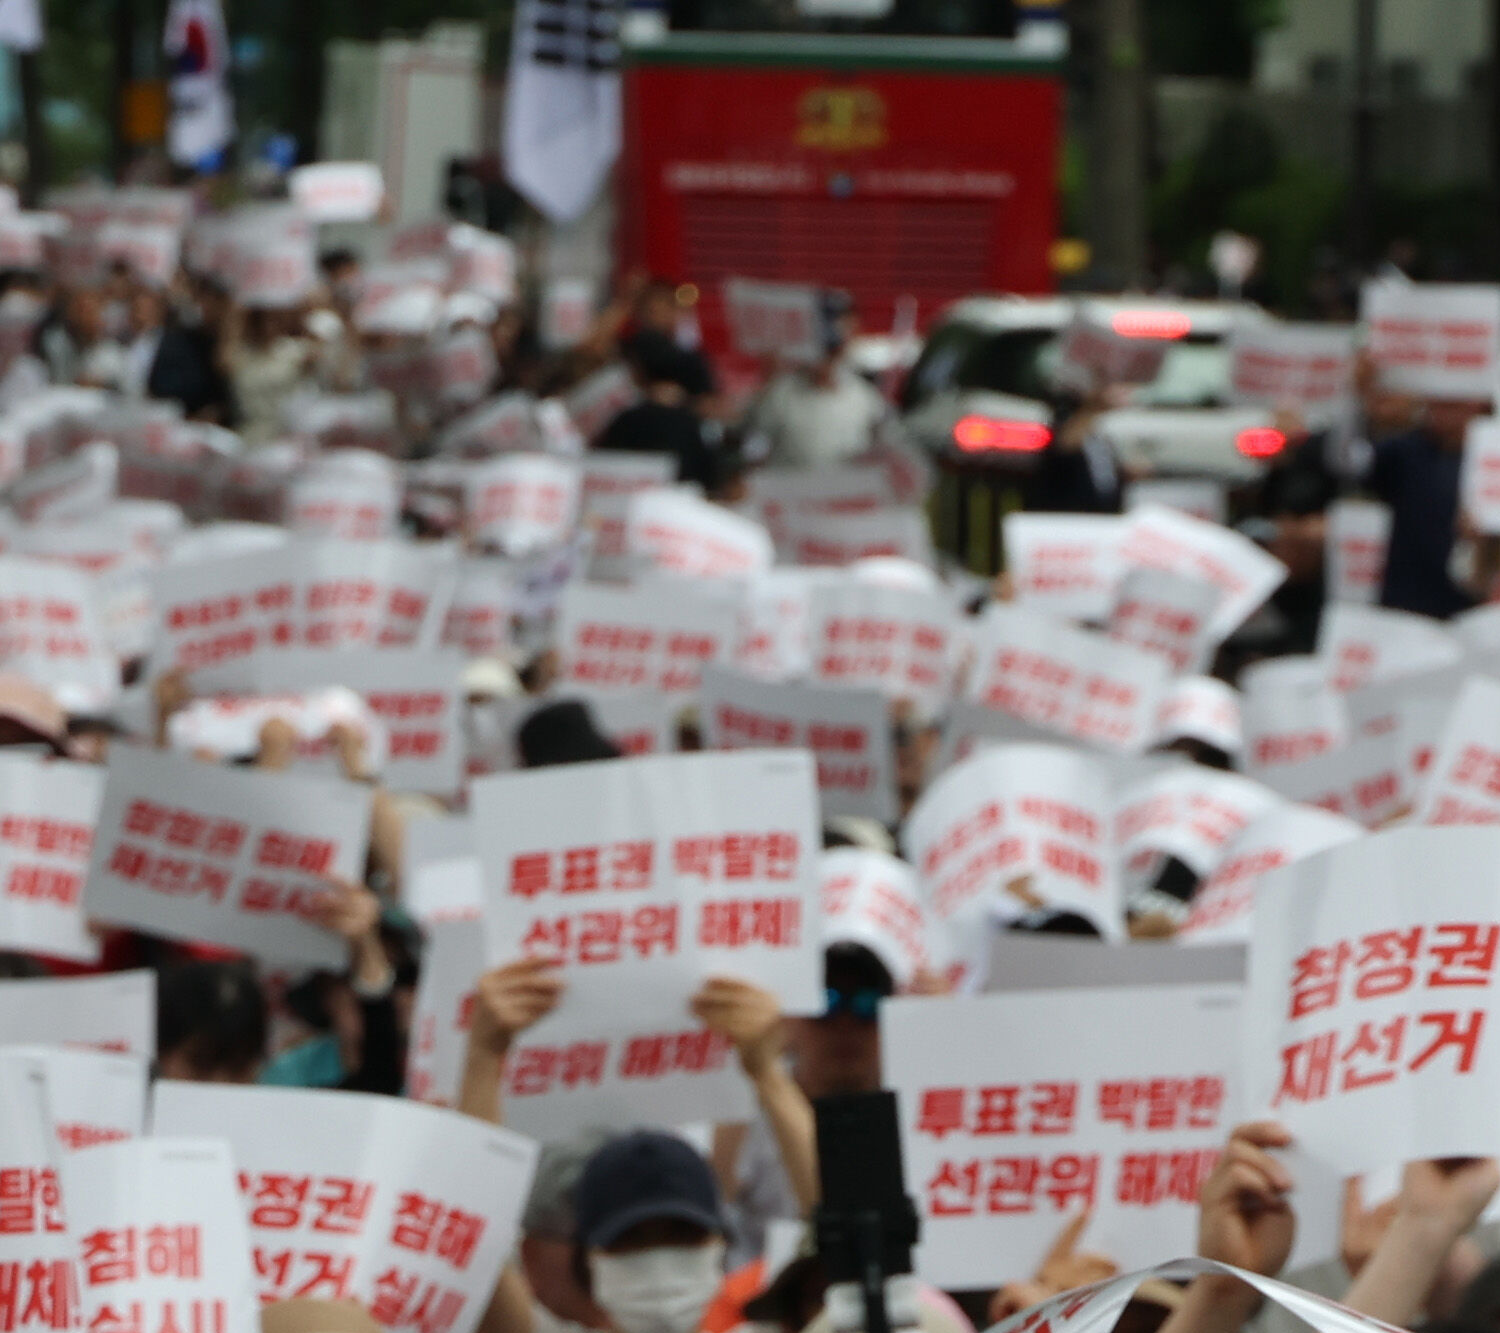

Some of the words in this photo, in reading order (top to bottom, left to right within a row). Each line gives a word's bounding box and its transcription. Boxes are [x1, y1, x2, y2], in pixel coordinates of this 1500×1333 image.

[8, 868, 80, 904] 해체
[511, 844, 652, 898] 투표권
[676, 834, 797, 880] 박탈한
[242, 870, 333, 924] 실시
[518, 906, 678, 968] 선관위
[702, 900, 802, 947] 해체!
[505, 1044, 606, 1094] 관위
[1272, 1010, 1486, 1106] 재선거
[919, 1084, 1076, 1138] 투표권
[1099, 1078, 1221, 1129] 박탈한
[930, 1155, 1098, 1216] 선관위
[1119, 1152, 1203, 1204] 해체
[238, 1174, 372, 1233] 정권
[392, 1194, 484, 1267] 침해
[84, 1228, 198, 1285] 침해
[254, 1249, 352, 1300] 선거
